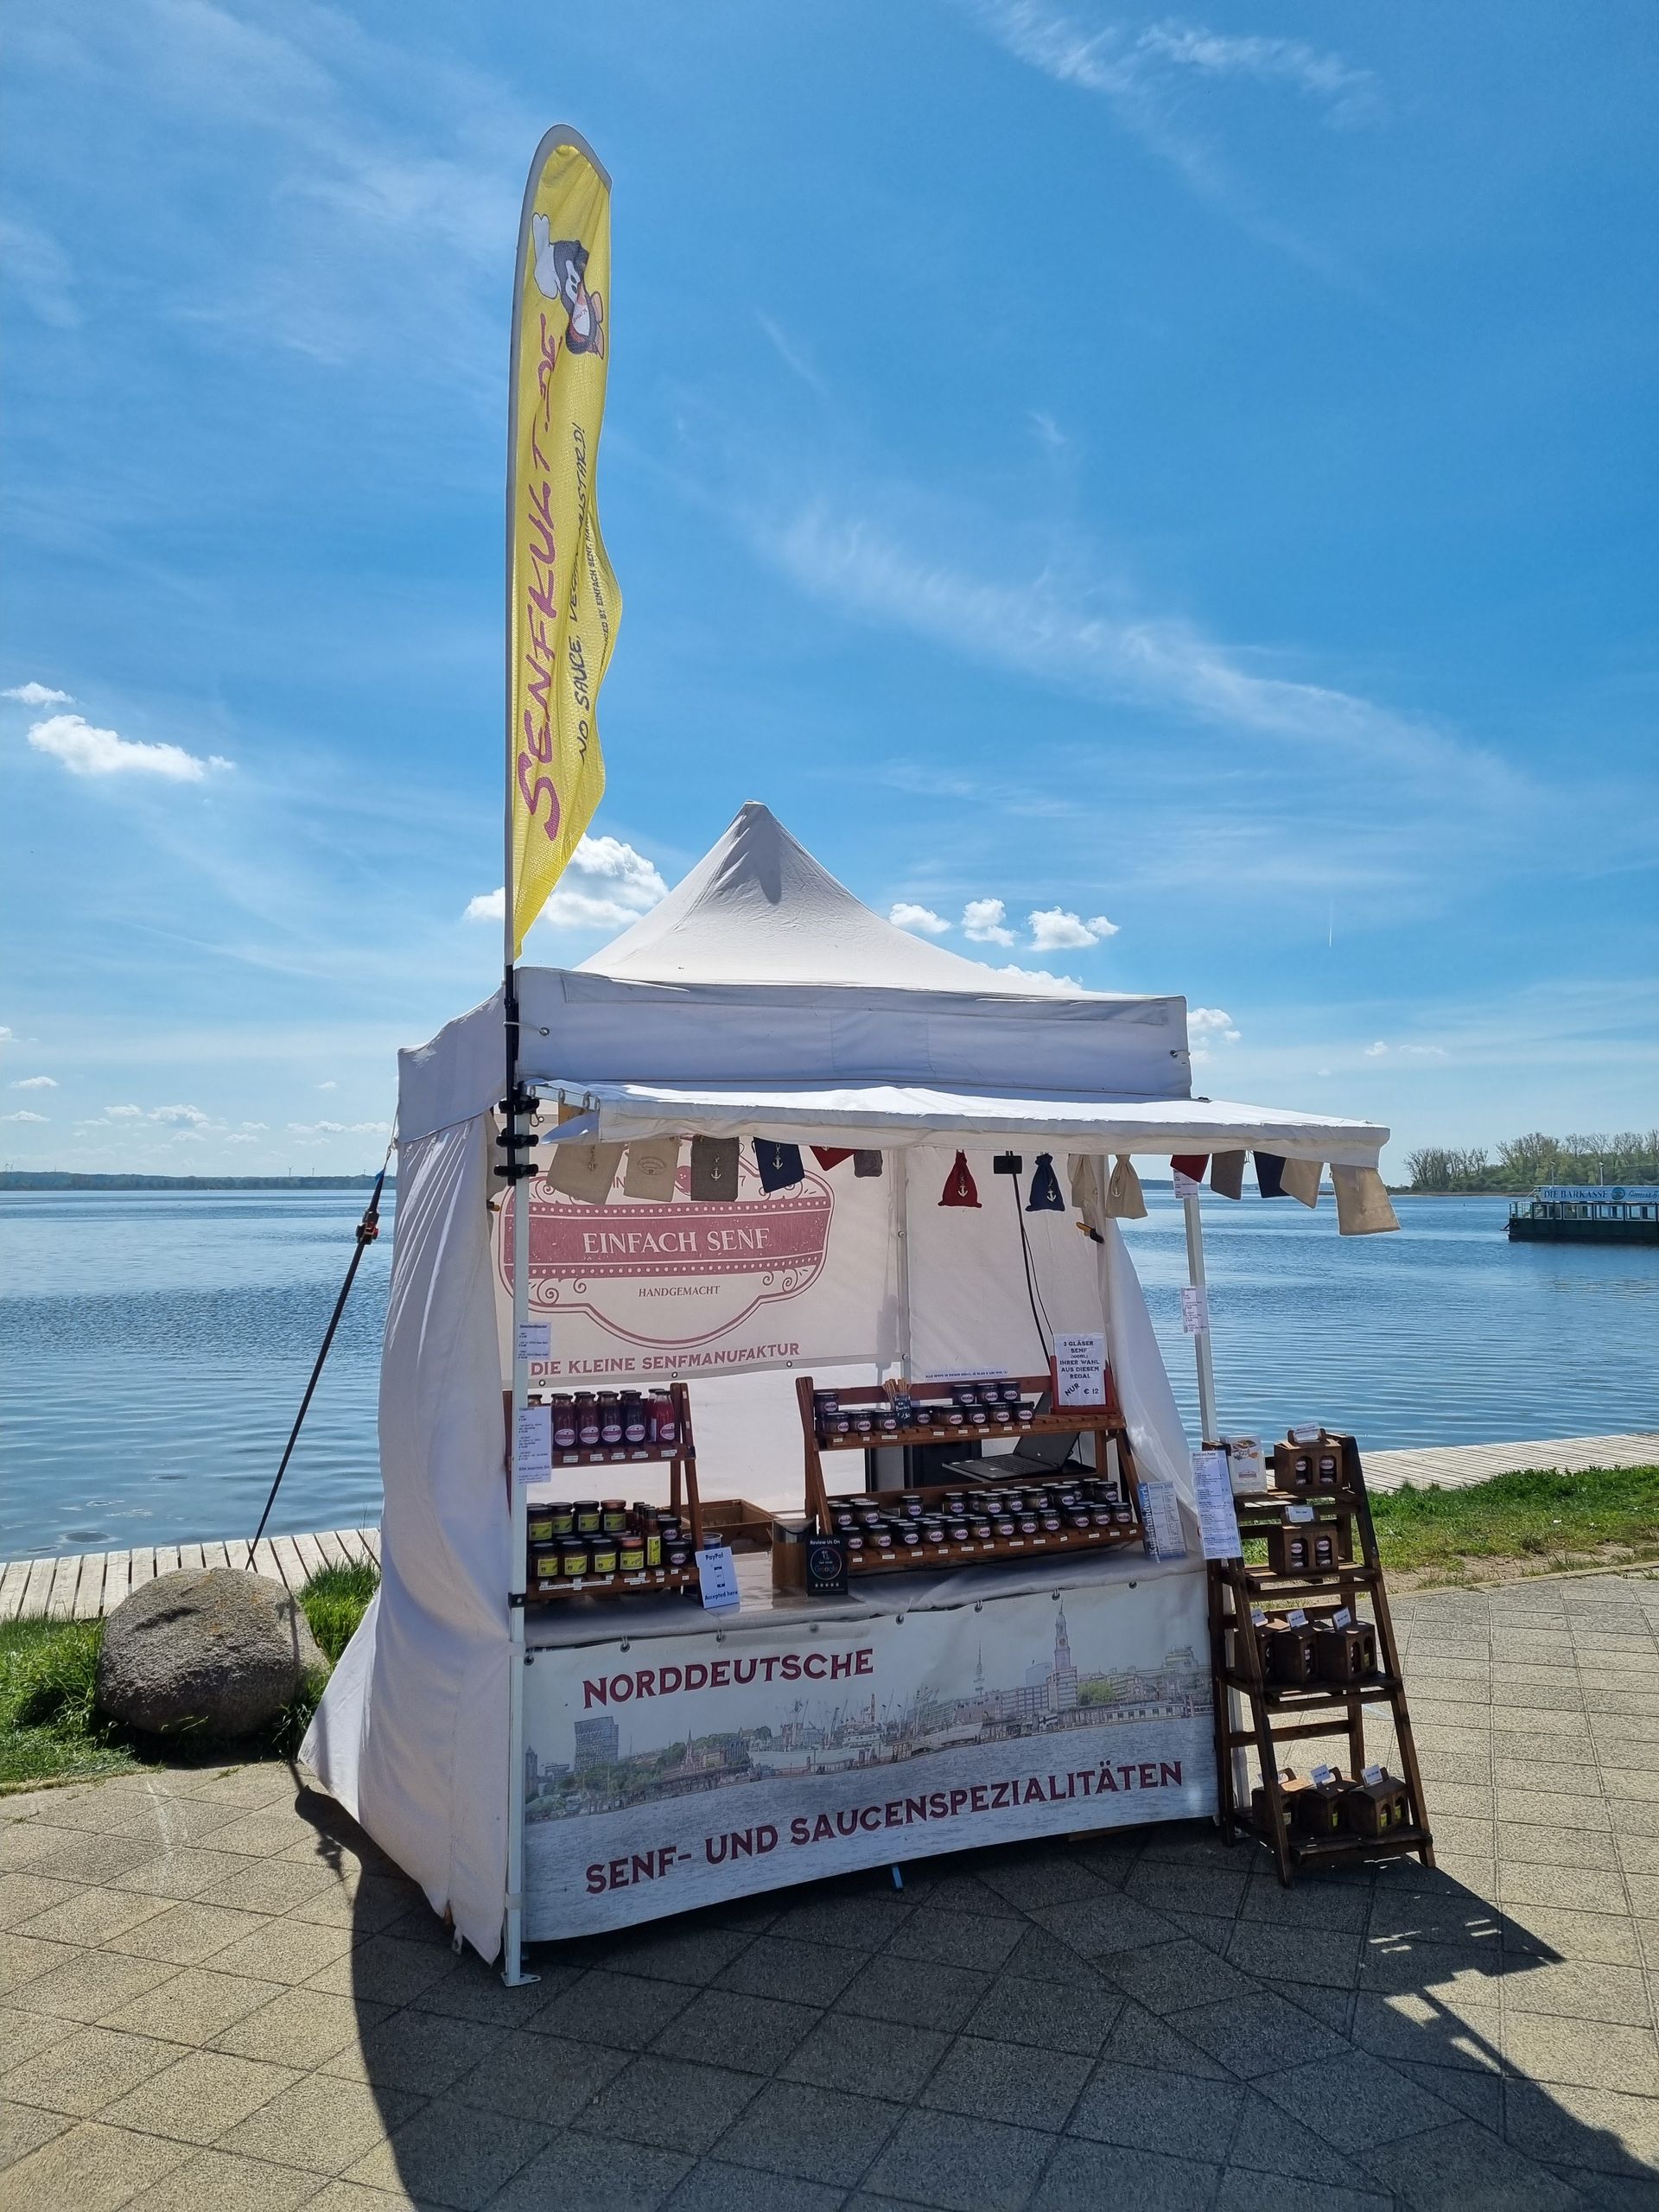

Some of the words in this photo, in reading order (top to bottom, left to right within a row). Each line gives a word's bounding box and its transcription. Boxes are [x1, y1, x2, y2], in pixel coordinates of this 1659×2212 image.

[589, 569, 604, 607] EINFACH
[598, 608, 607, 620] BY
[569, 635, 590, 712] SAUCE,
[576, 720, 589, 766] NO
[582, 1231, 697, 1254] EINFACH
[707, 1228, 770, 1251] SENF
[639, 1286, 721, 1297] HANDGEMACHT
[531, 1361, 561, 1376] DIE
[568, 1357, 635, 1374] KLEINE
[641, 1342, 800, 1370] SENFMANUFAKTUR
[1064, 1382, 1080, 1396] NUR
[705, 1552, 724, 1561] PayPal
[705, 1592, 726, 1600] Accepted
[582, 1648, 874, 1708] NORDDEUTSCHE
[586, 1846, 691, 1894] SENF-
[705, 1824, 778, 1864] UND
[790, 1760, 1183, 1847] SAUCENSPEZIALITÄTEN
